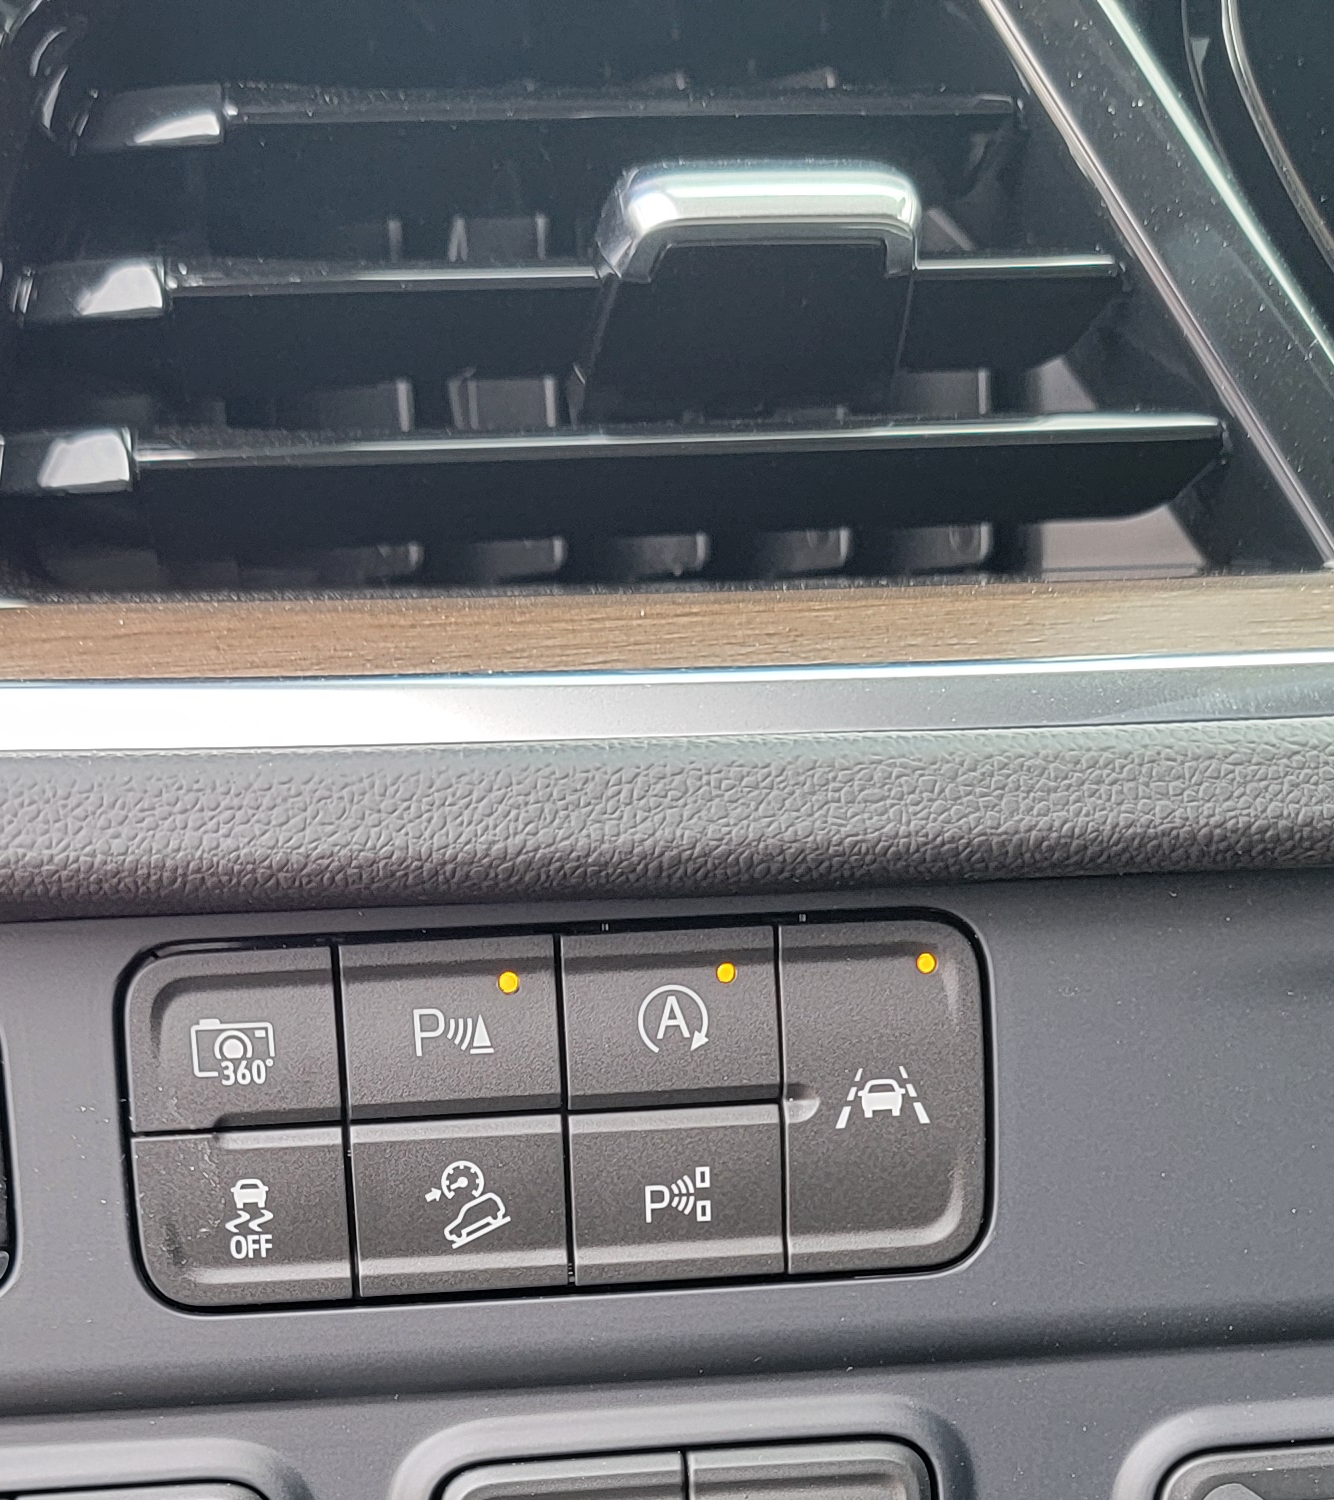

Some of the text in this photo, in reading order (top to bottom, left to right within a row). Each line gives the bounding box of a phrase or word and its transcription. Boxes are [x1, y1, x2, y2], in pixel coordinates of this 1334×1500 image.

[412, 1008, 446, 1057] P
[656, 995, 692, 1039] A
[644, 1184, 671, 1223] P
[229, 1234, 274, 1260] OFF
